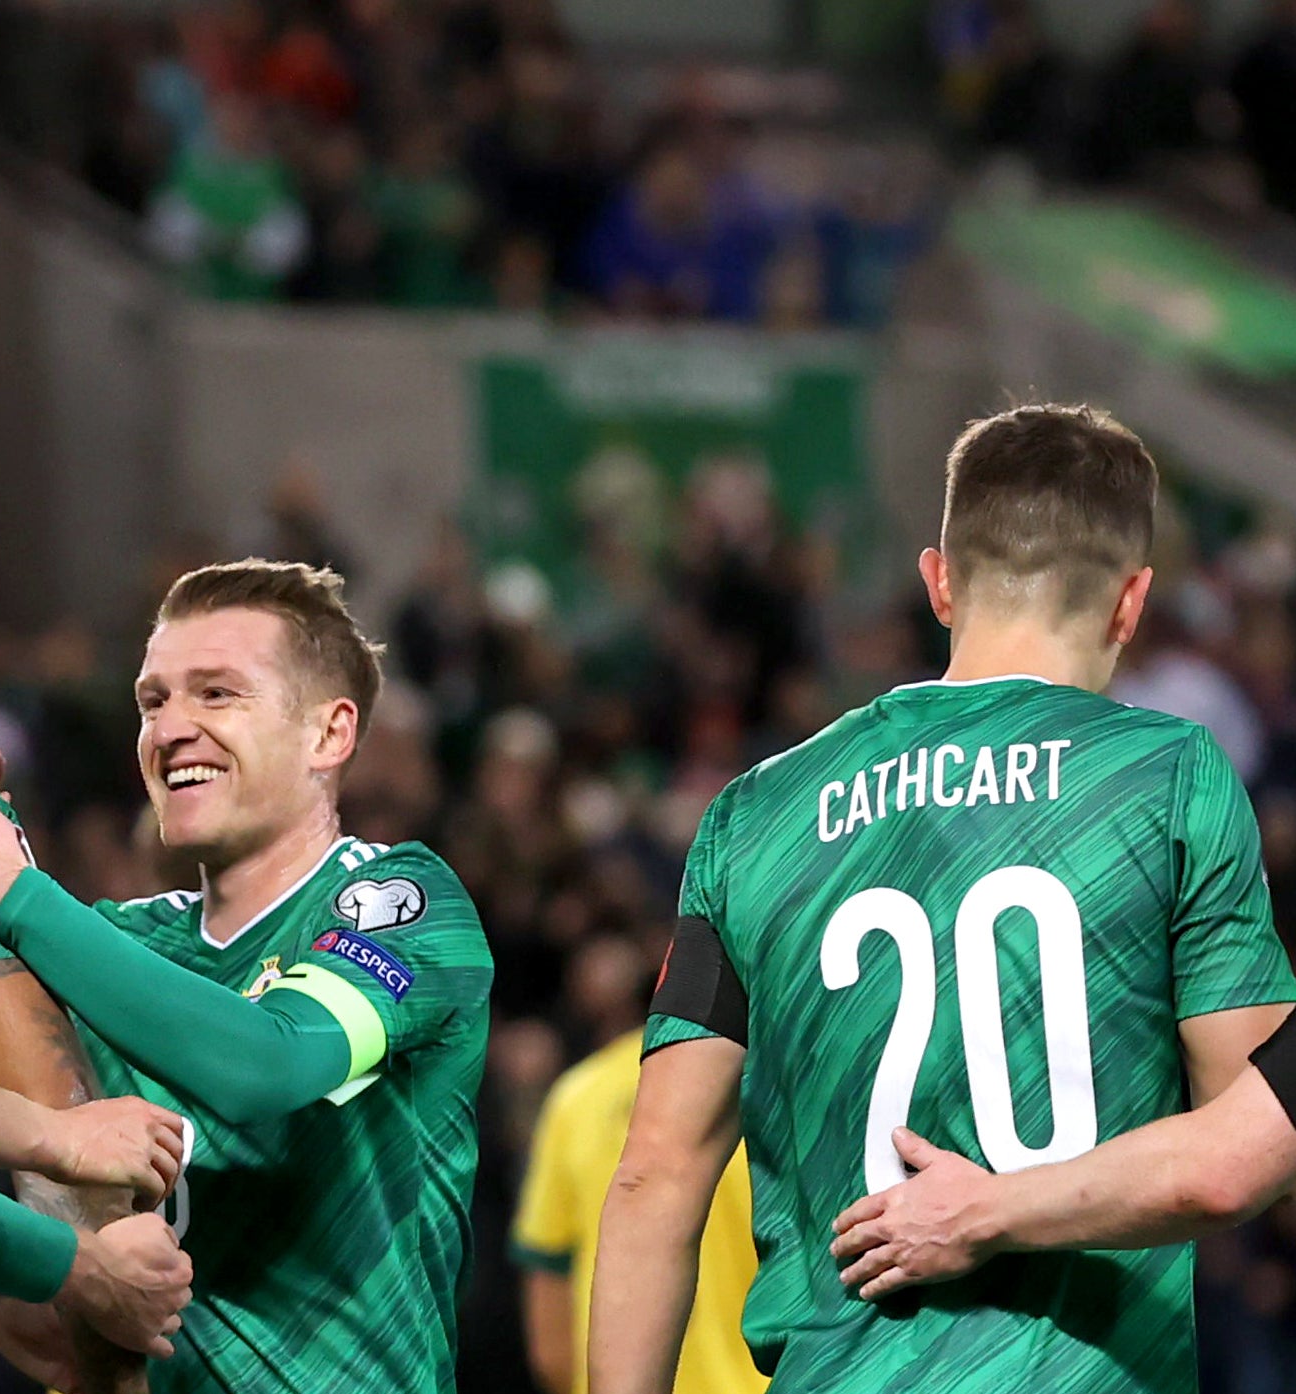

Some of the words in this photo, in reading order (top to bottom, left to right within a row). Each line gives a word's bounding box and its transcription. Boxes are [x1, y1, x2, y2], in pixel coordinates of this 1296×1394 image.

[817, 739, 1072, 843] CATHCART
[334, 937, 409, 993] RESPECT
[820, 866, 1097, 1196] 20
